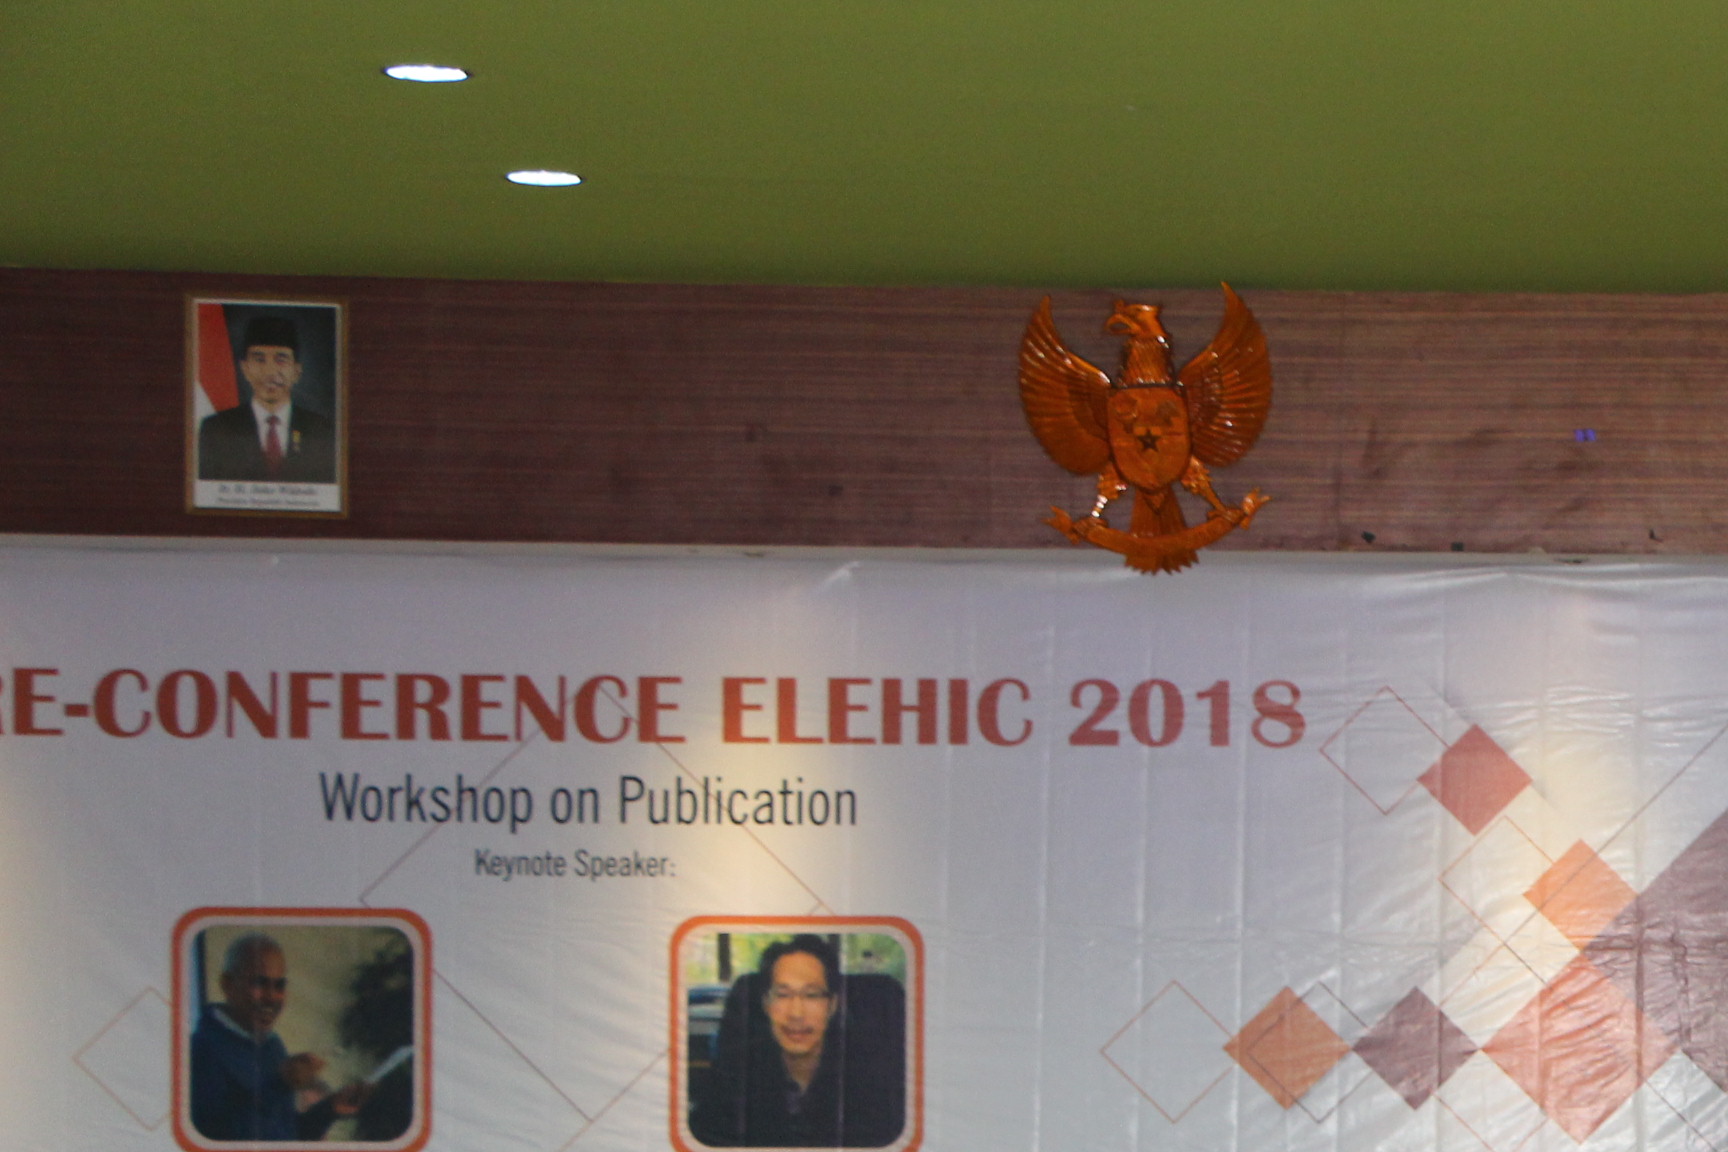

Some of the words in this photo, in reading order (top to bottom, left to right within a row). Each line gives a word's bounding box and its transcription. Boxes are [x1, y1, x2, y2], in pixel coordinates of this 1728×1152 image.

[0, 667, 687, 744] E-CONFERENCE
[722, 675, 1034, 747] ELEHIC
[1068, 678, 1306, 749] 2018
[318, 771, 535, 835] Workshop
[551, 786, 599, 825] on
[619, 774, 857, 826] Publication
[474, 849, 568, 882] Keynote
[574, 849, 677, 882] Speaker:
